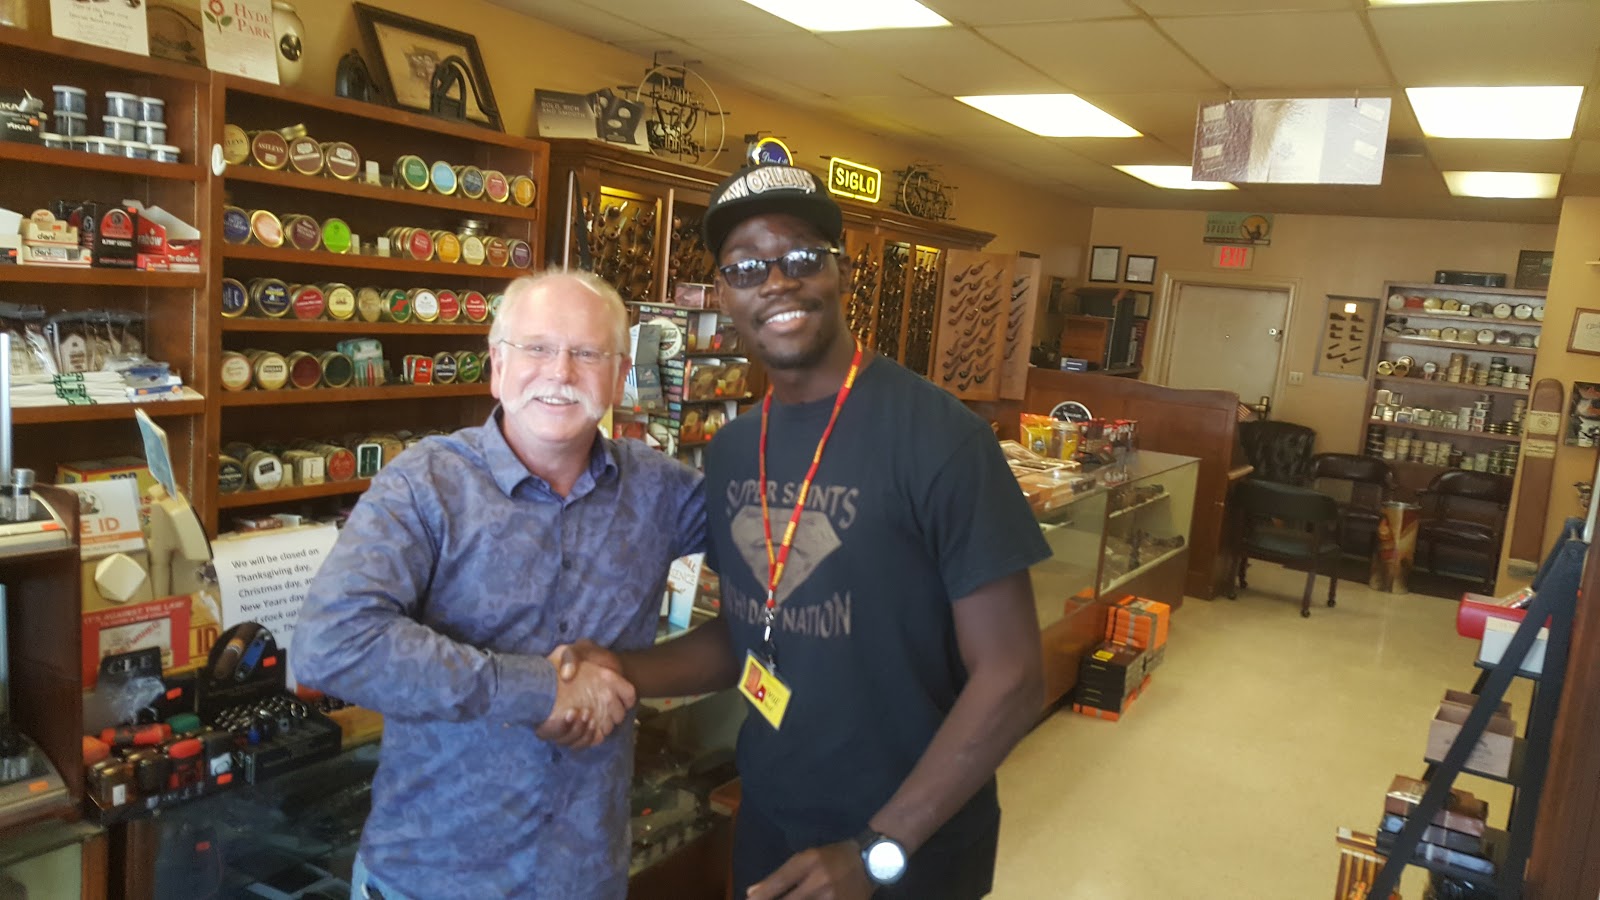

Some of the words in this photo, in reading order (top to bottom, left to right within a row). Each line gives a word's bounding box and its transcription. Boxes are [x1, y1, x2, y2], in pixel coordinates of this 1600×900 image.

[234, 2, 271, 25] HYDE
[237, 18, 272, 40] PARK
[257, 141, 284, 153] ASTLEYS
[835, 167, 876, 195] SIGLO
[1219, 246, 1248, 268] EXIT
[99, 517, 120, 532] ID
[231, 560, 248, 569] We
[250, 556, 265, 566] will
[266, 555, 278, 563] be
[280, 549, 306, 561] closed
[308, 547, 320, 555] on
[235, 566, 293, 583] Thanksgiving
[238, 583, 283, 598] Christmas
[105, 606, 143, 621] AGAINST
[145, 604, 162, 613] THE
[240, 604, 262, 613] New
[262, 597, 288, 608] Years
[260, 613, 283, 624] stock
[783, 590, 851, 639] NATION
